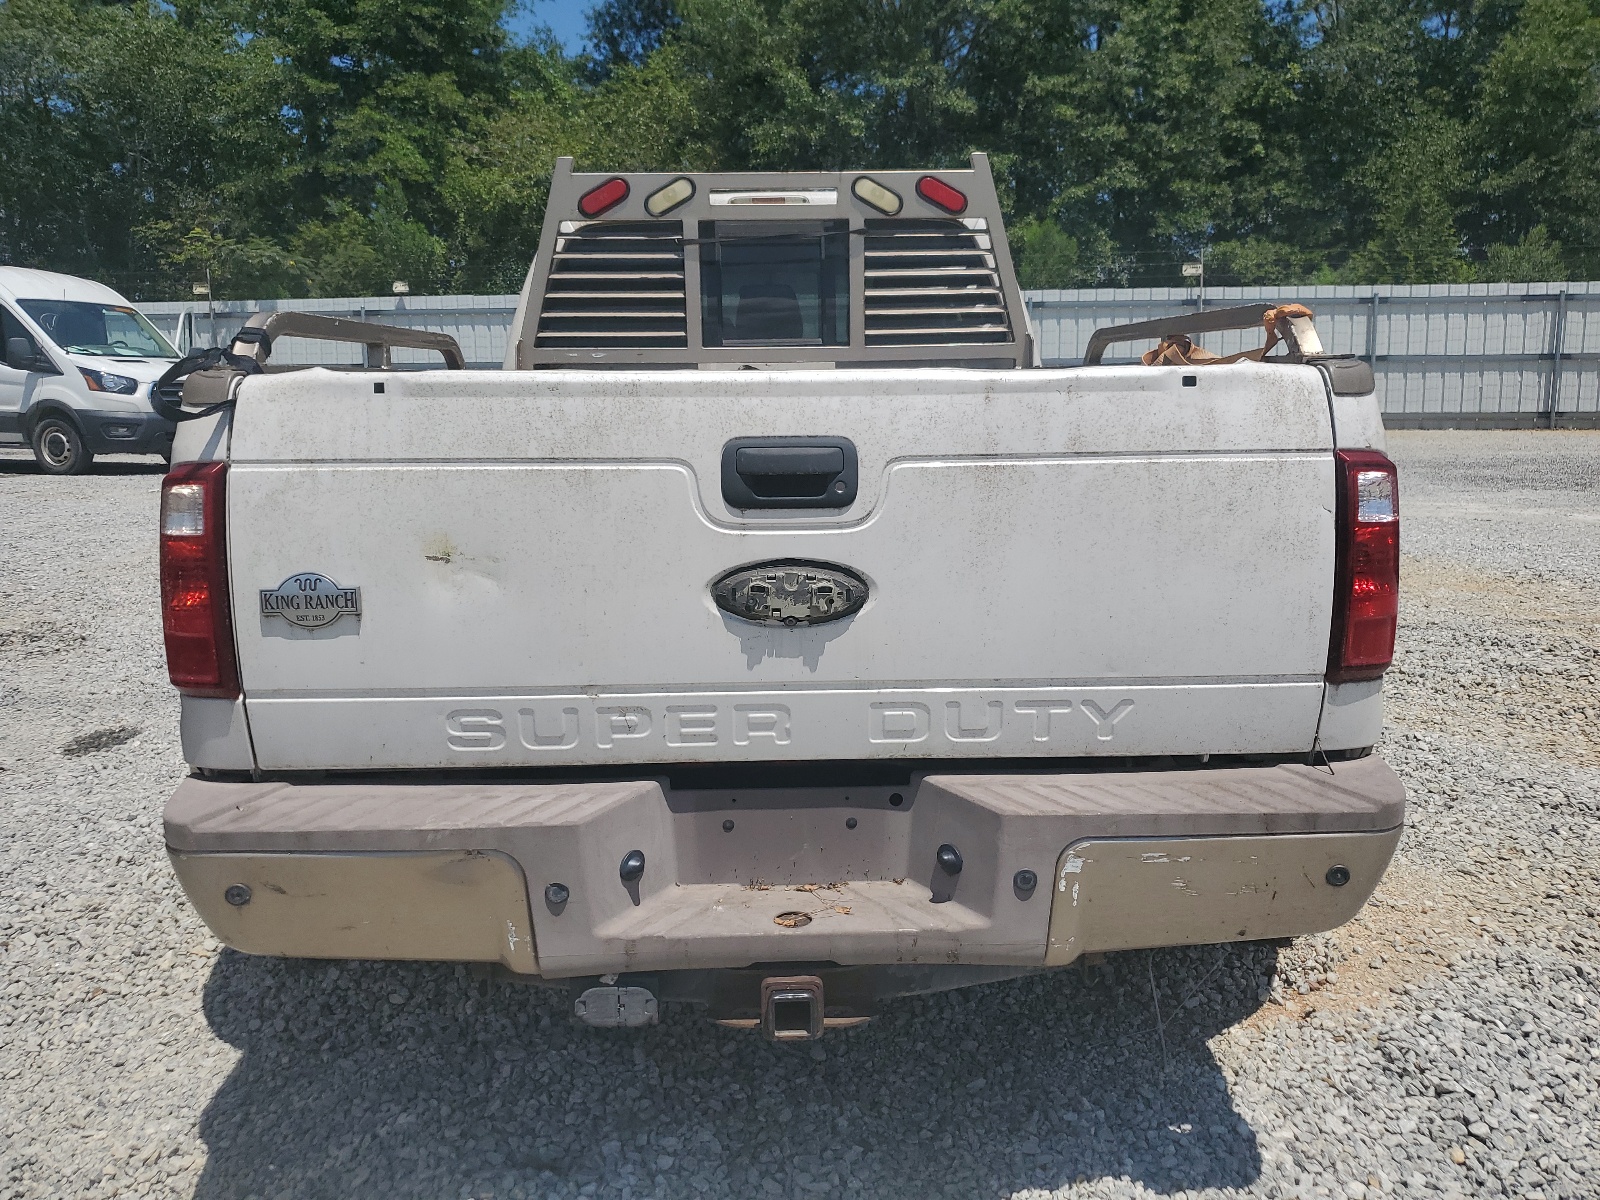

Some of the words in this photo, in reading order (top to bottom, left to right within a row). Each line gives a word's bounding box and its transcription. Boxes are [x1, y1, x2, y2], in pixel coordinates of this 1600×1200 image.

[263, 593, 300, 610] KING
[304, 591, 356, 610] RANCH
[447, 703, 792, 750] SUPER
[869, 698, 1135, 744] DUTY
